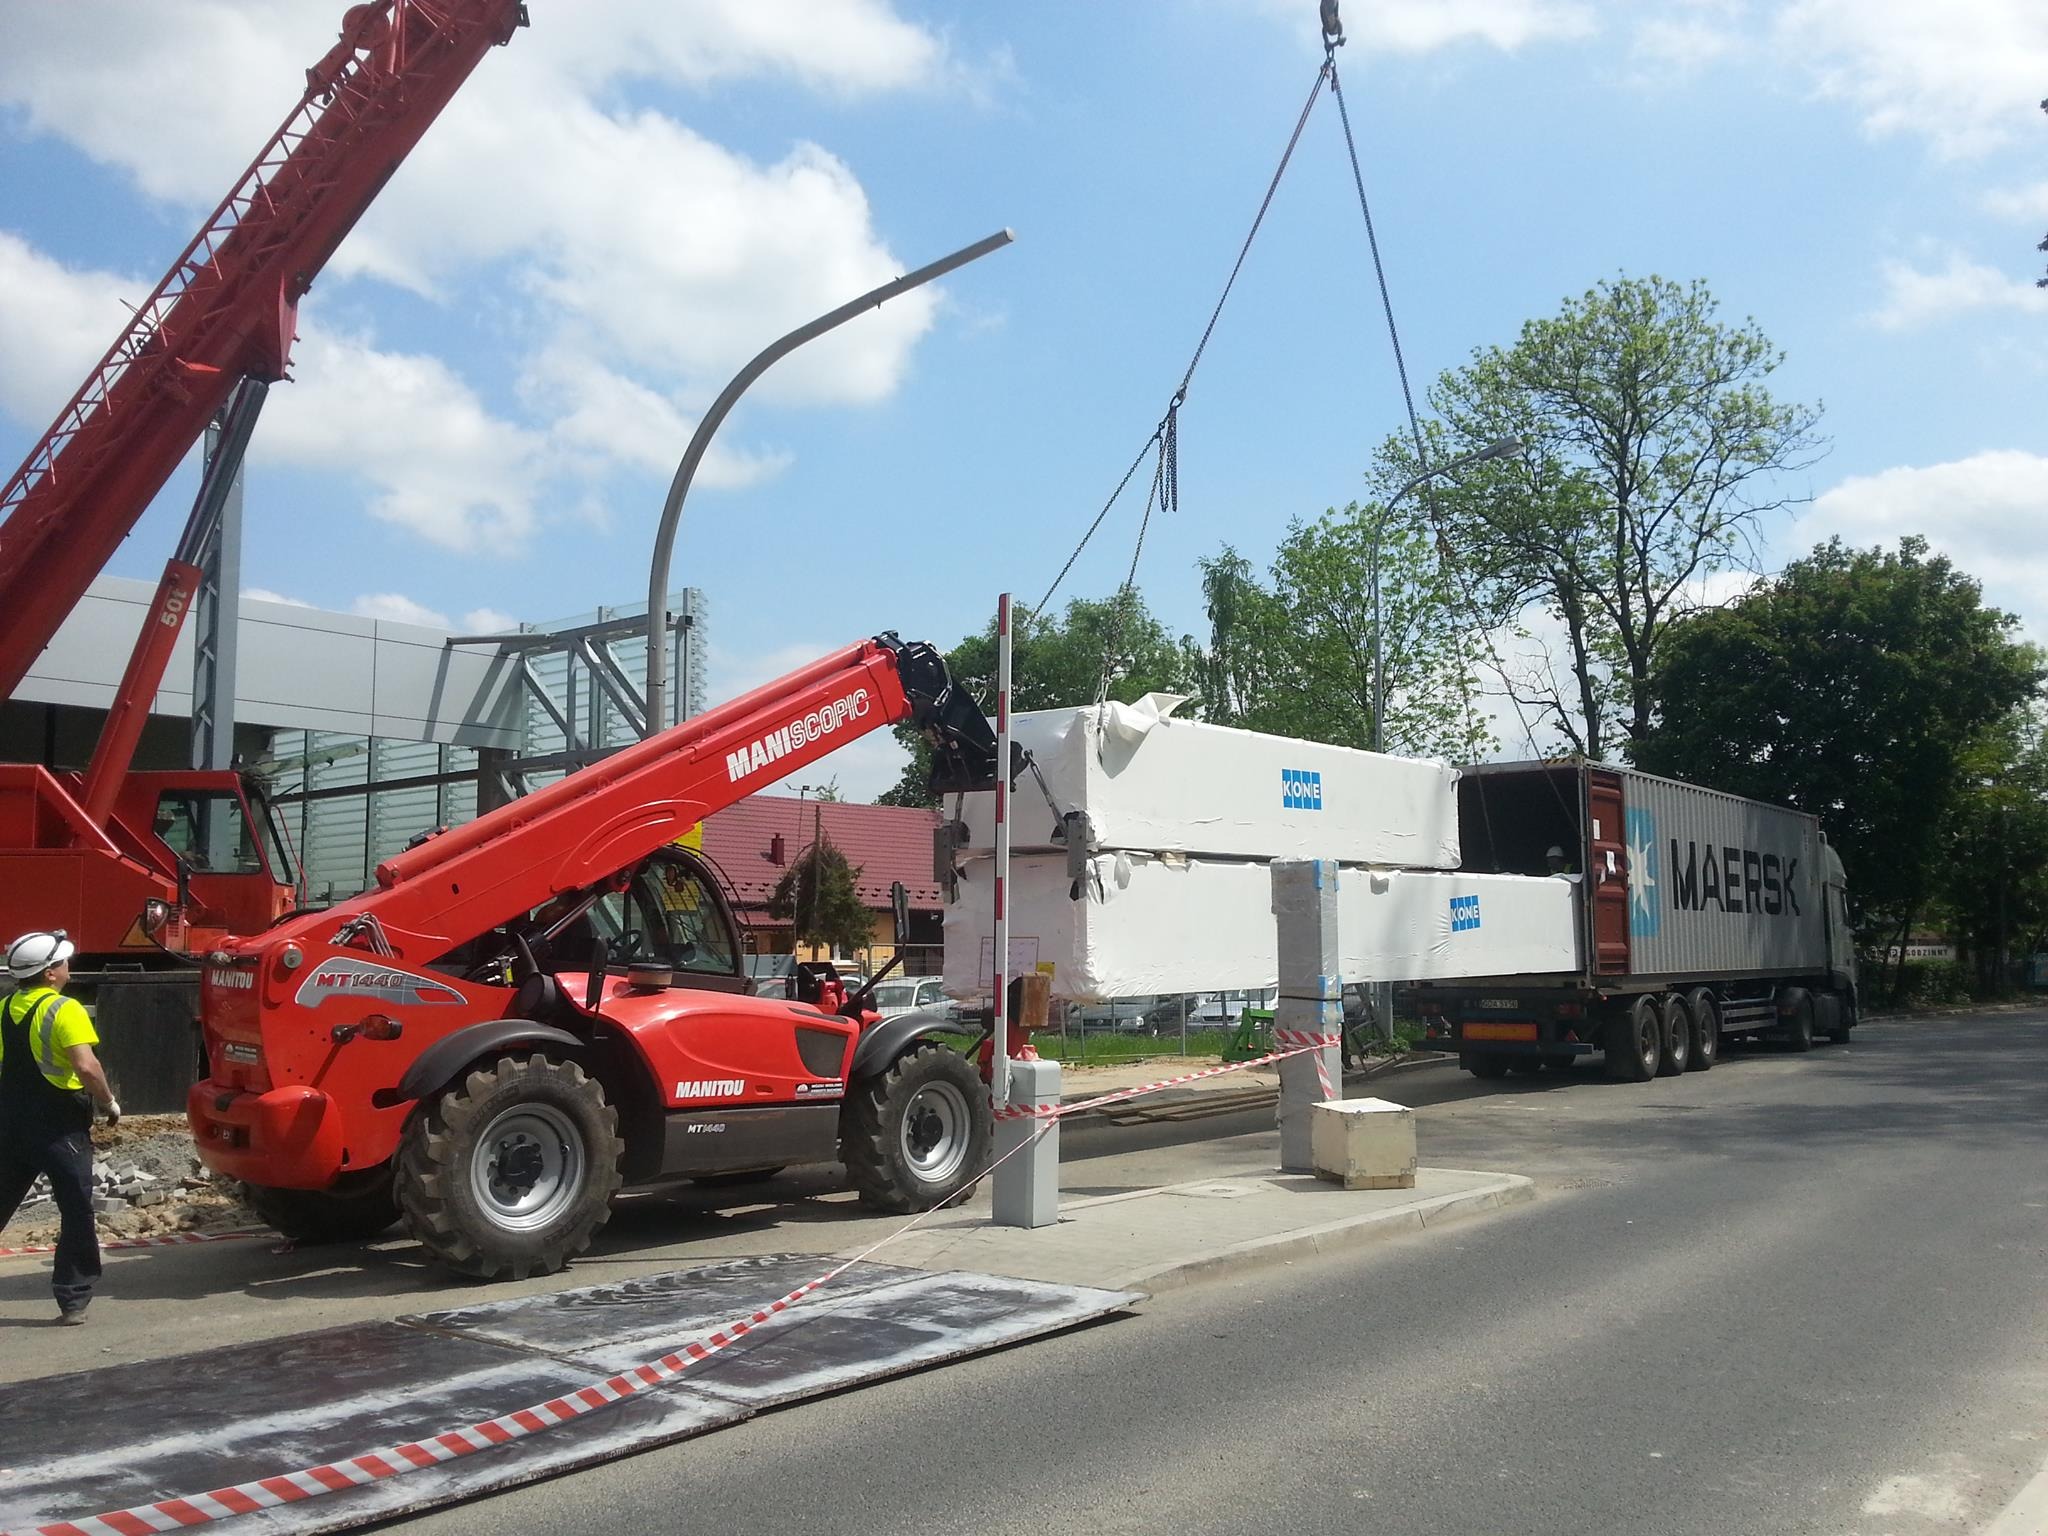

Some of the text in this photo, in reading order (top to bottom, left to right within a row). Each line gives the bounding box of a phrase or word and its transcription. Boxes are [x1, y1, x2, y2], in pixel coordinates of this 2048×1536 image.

[726, 688, 870, 783] MANISCOPIC
[1282, 780, 1321, 799] KONE
[1670, 838, 1801, 916] MAERSK
[1451, 905, 1480, 922] KONE
[211, 969, 254, 990] MANITOU
[316, 973, 403, 988] MT1440
[675, 1079, 746, 1099] MANITOU
